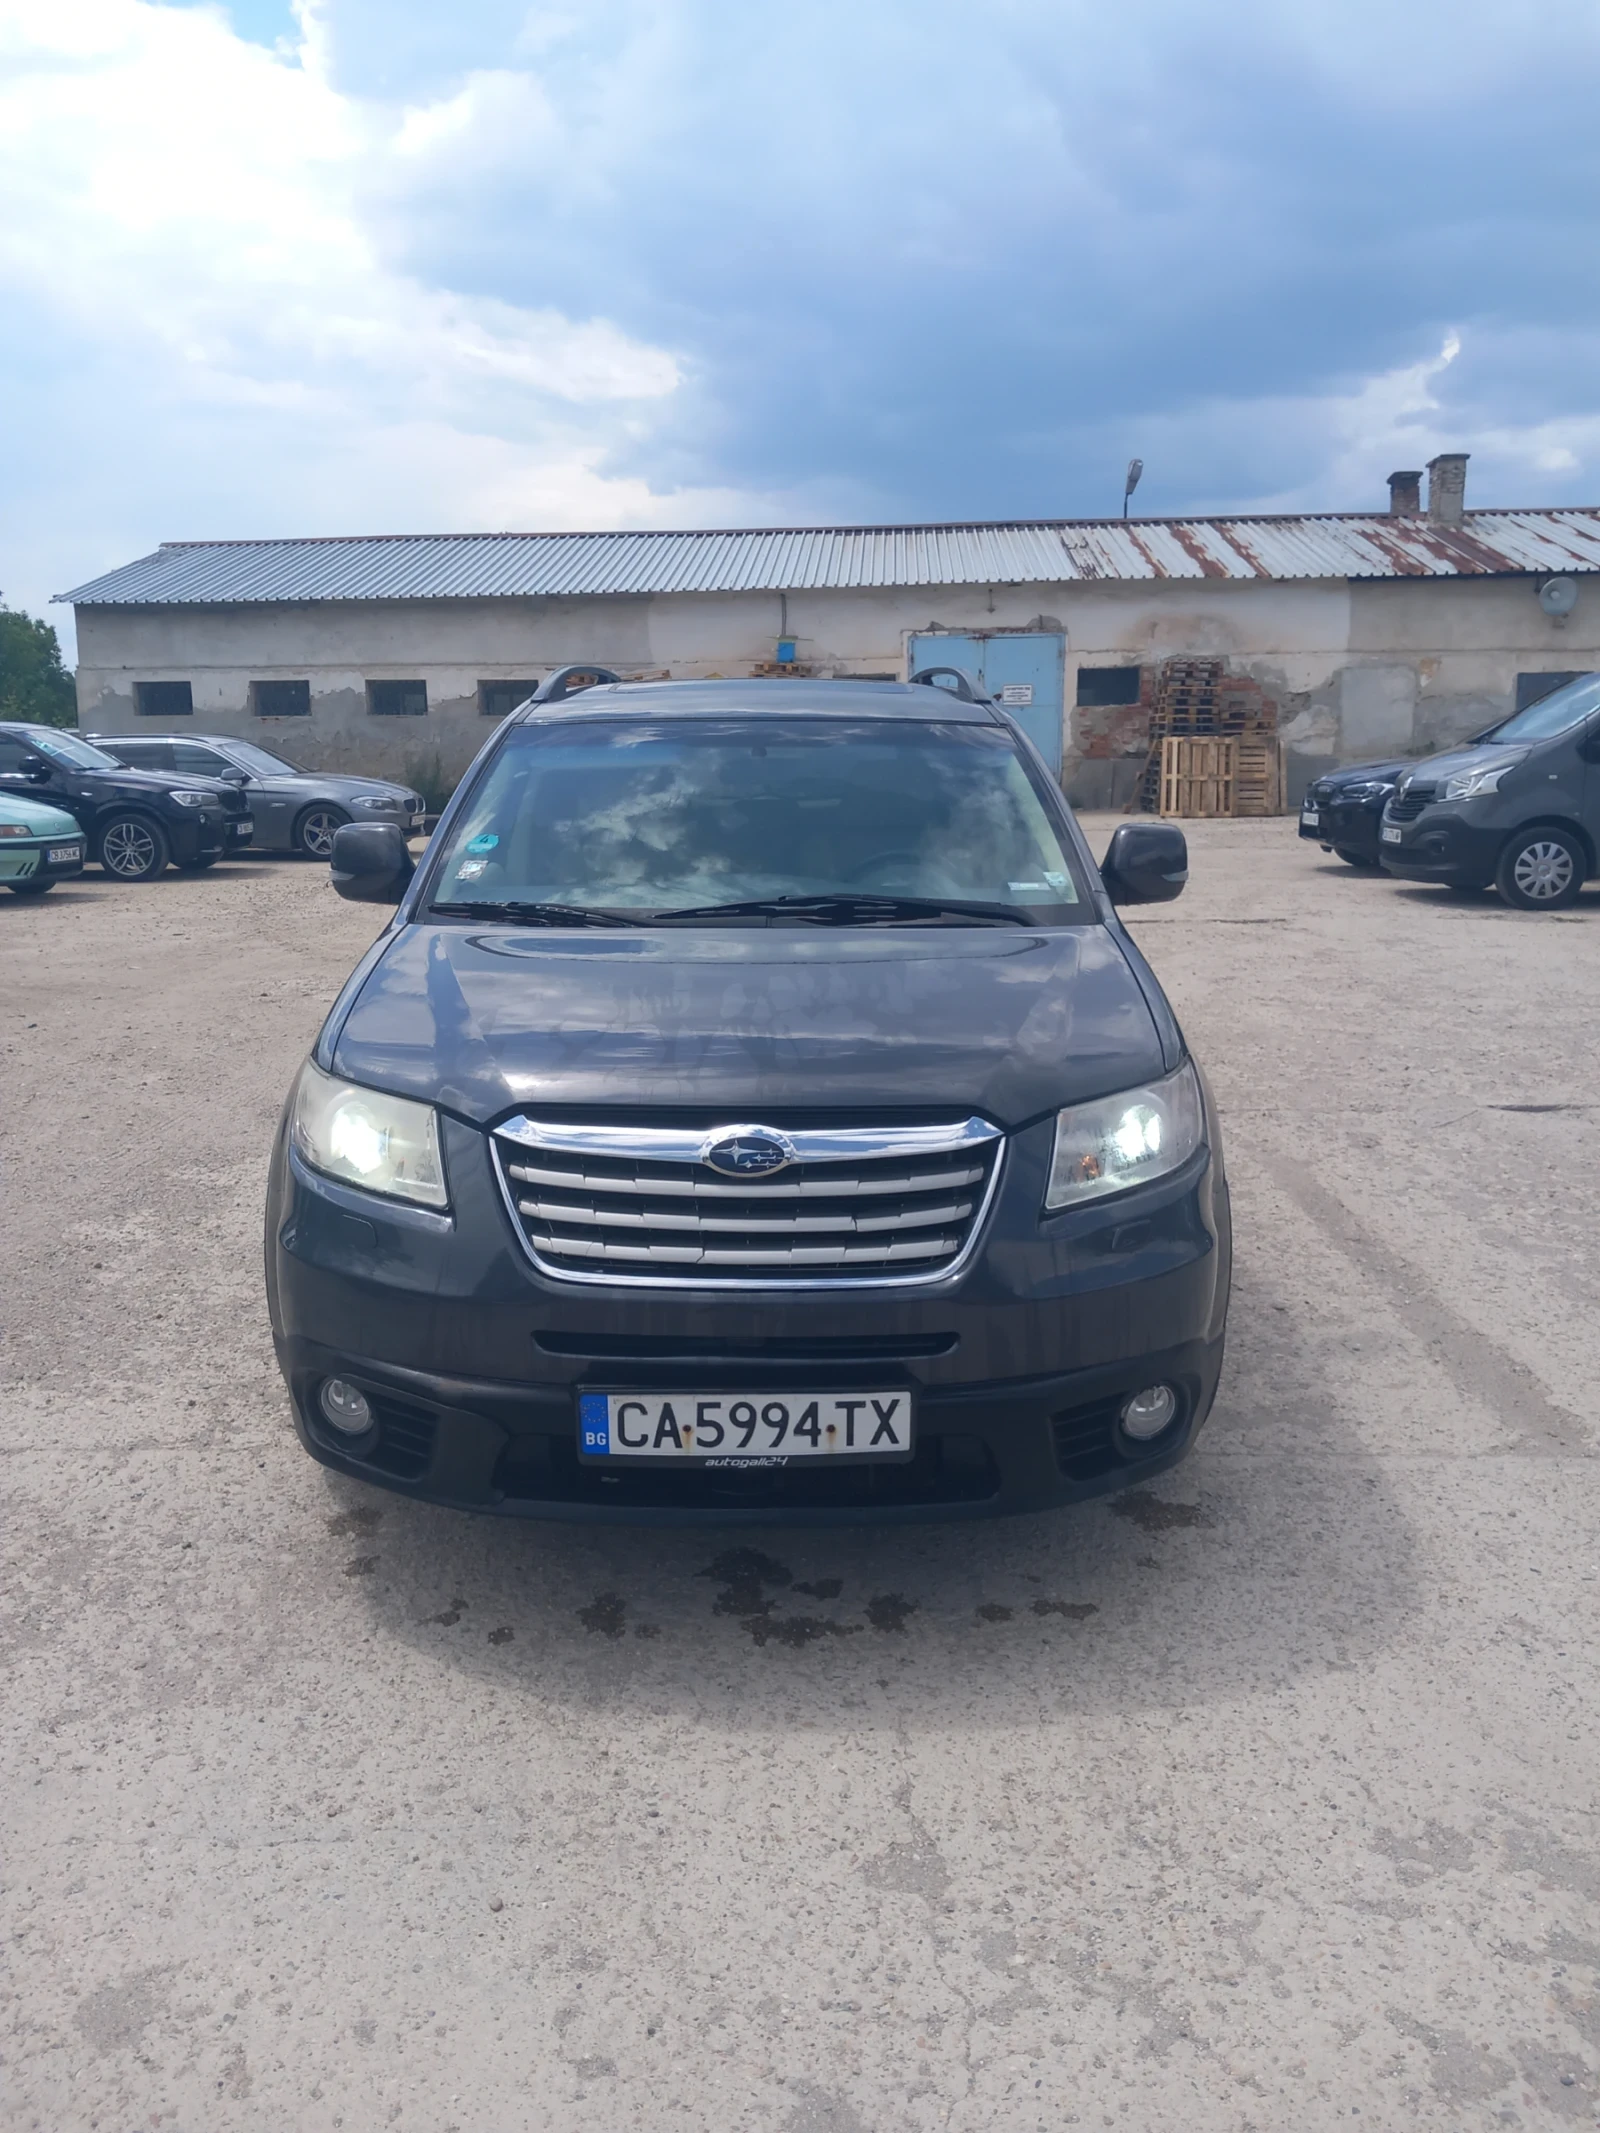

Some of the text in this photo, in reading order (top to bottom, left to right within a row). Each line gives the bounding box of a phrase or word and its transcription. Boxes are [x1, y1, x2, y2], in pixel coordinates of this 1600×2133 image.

[586, 1432, 607, 1446] BG
[617, 1398, 900, 1449] CA 5994 TX
